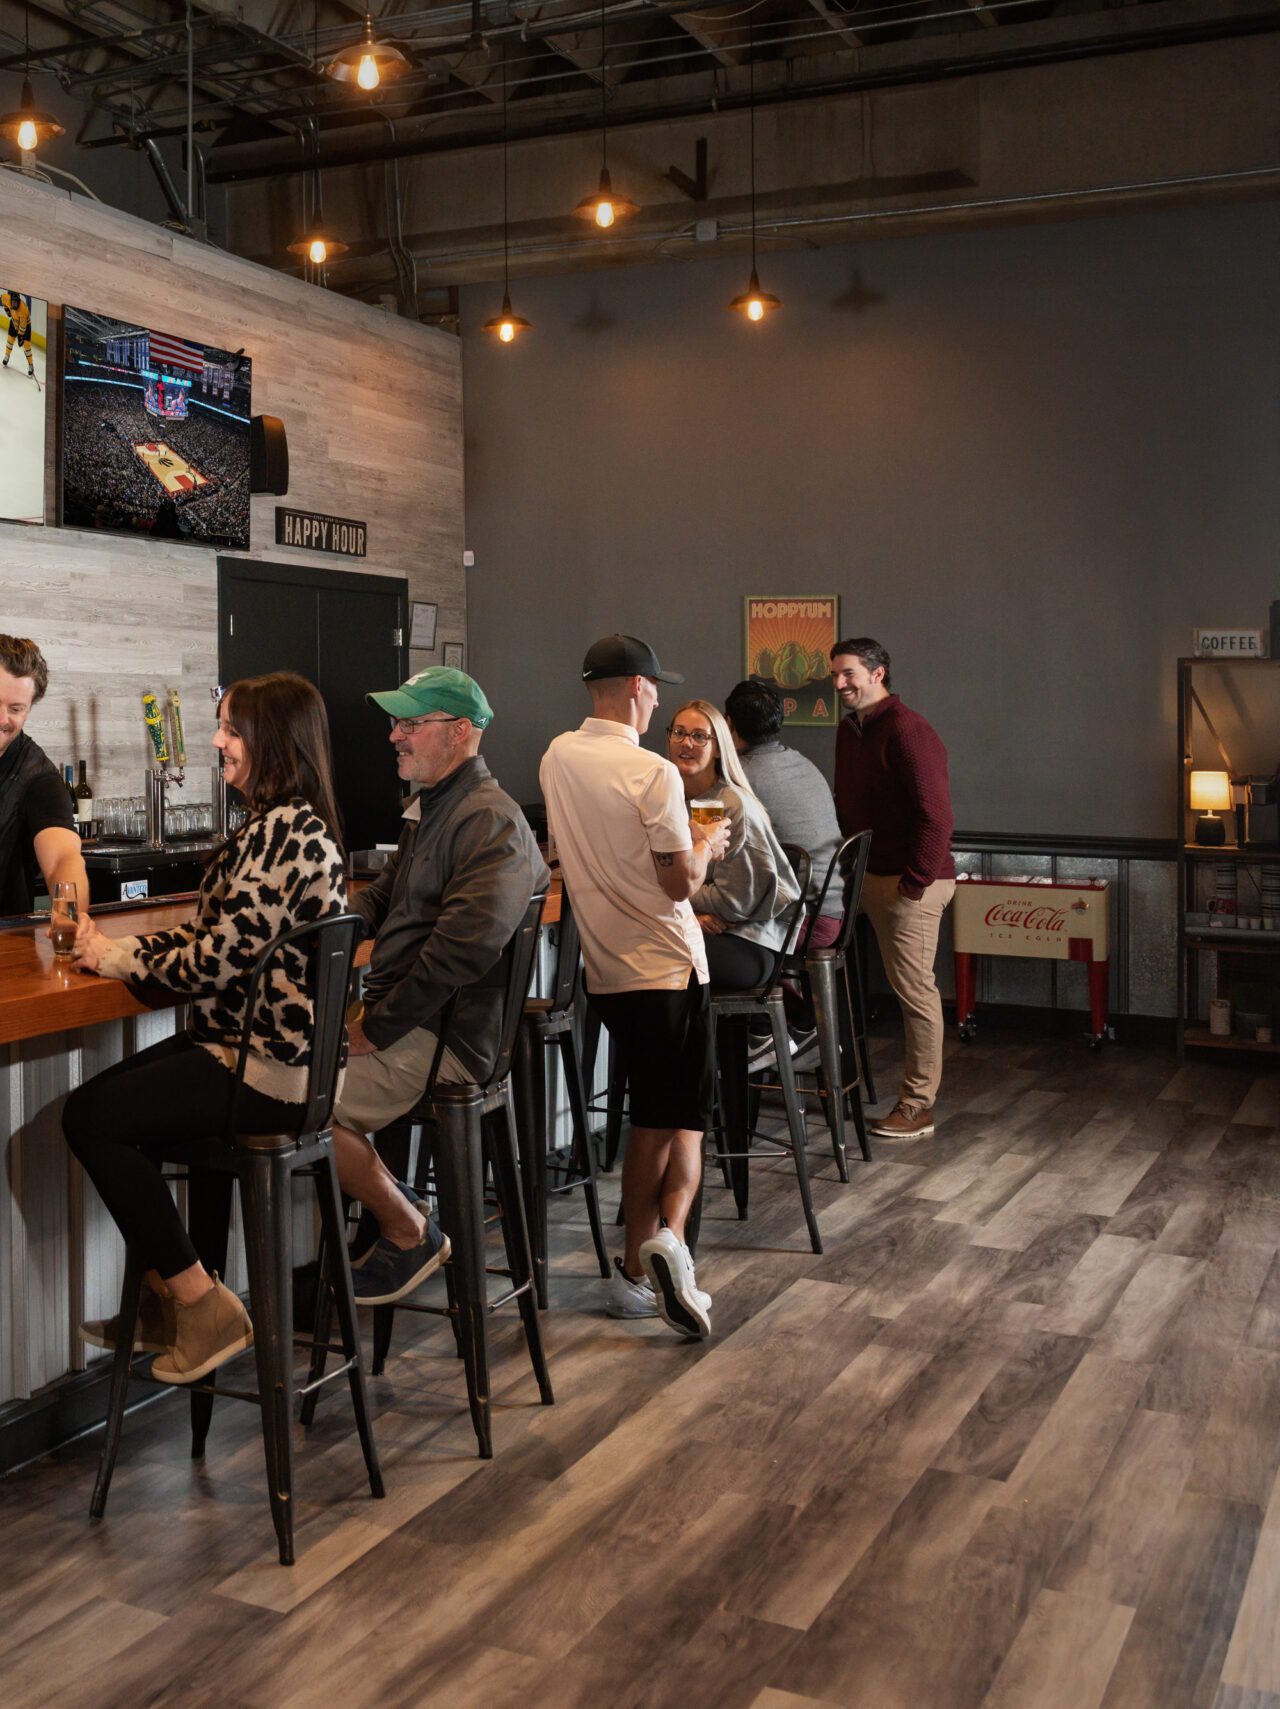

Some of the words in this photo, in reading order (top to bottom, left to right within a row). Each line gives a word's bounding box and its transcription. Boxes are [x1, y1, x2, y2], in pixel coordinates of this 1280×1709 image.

[285, 515, 328, 550] HAPPY
[332, 523, 365, 556] HOUR
[751, 602, 832, 619] HOPPYUM
[1201, 636, 1257, 650] COFFEE
